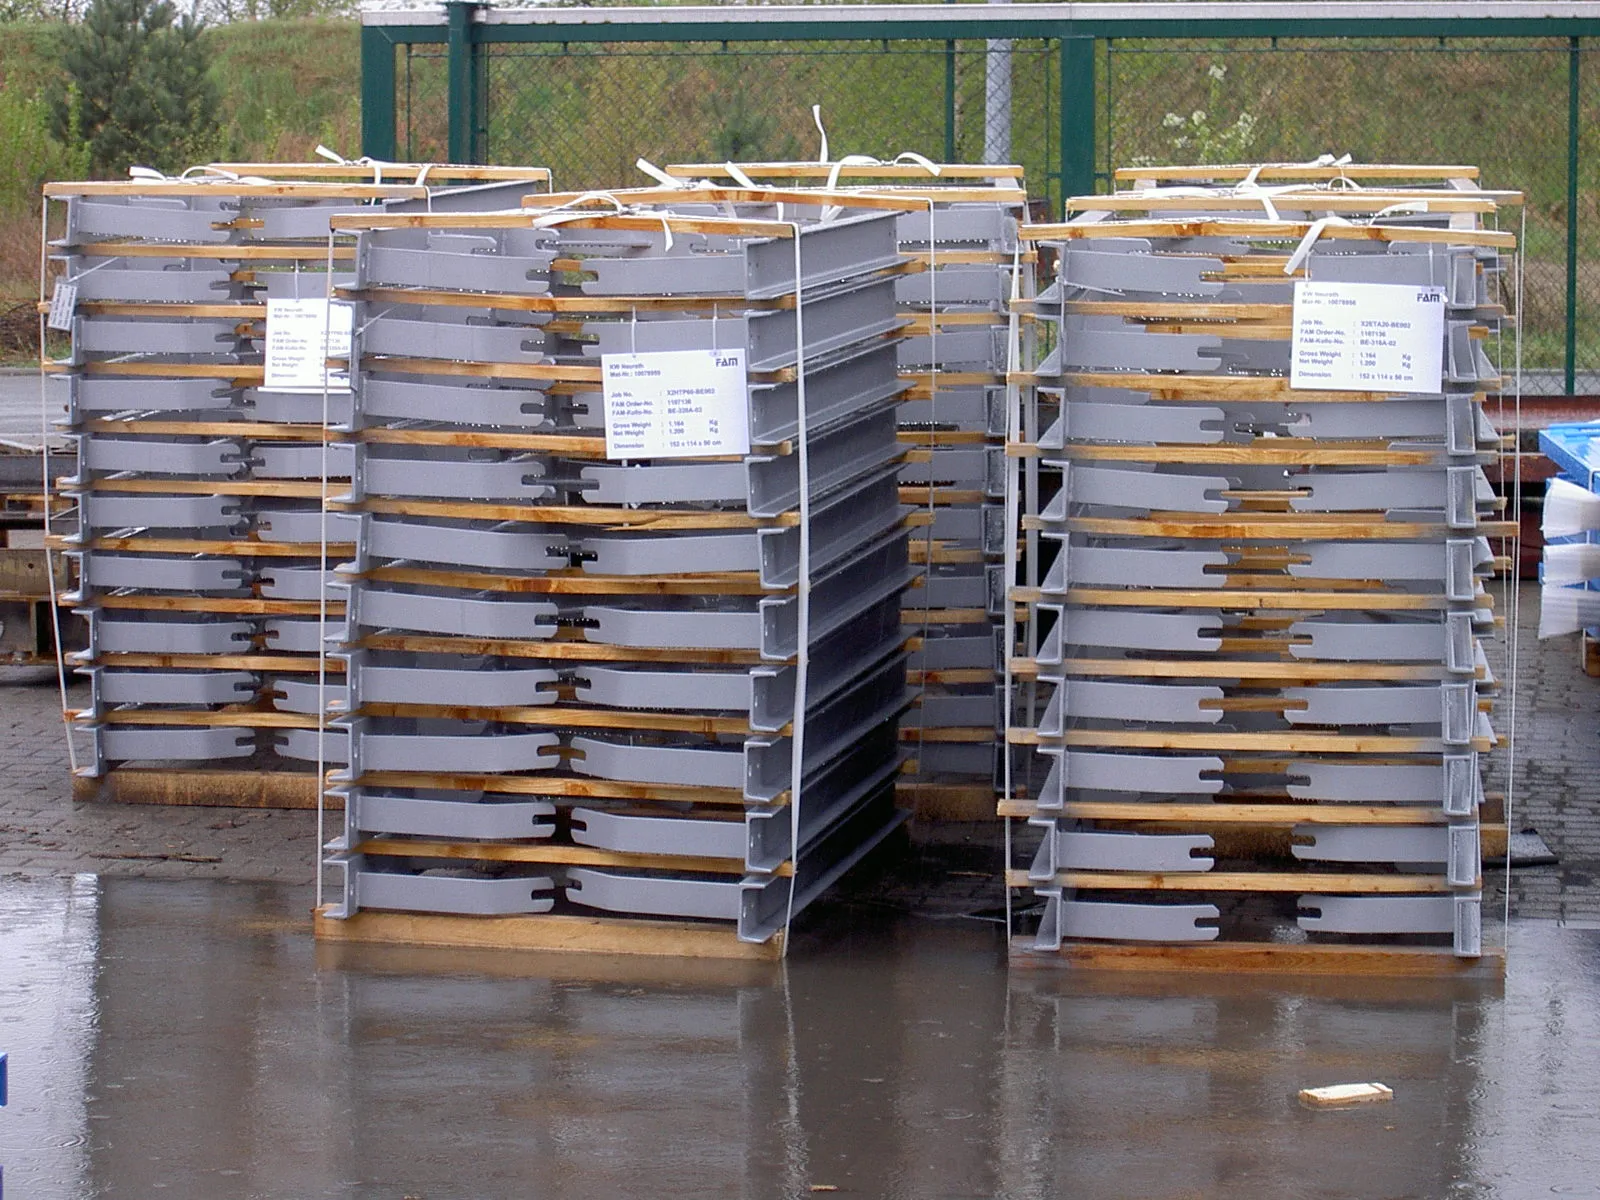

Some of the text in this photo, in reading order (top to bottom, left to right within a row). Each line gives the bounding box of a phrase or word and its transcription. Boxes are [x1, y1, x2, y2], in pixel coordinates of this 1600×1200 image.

[1416, 293, 1440, 302] FAM
[715, 357, 738, 367] FAM
[631, 421, 652, 430] Weight
[624, 430, 645, 438] Weight
